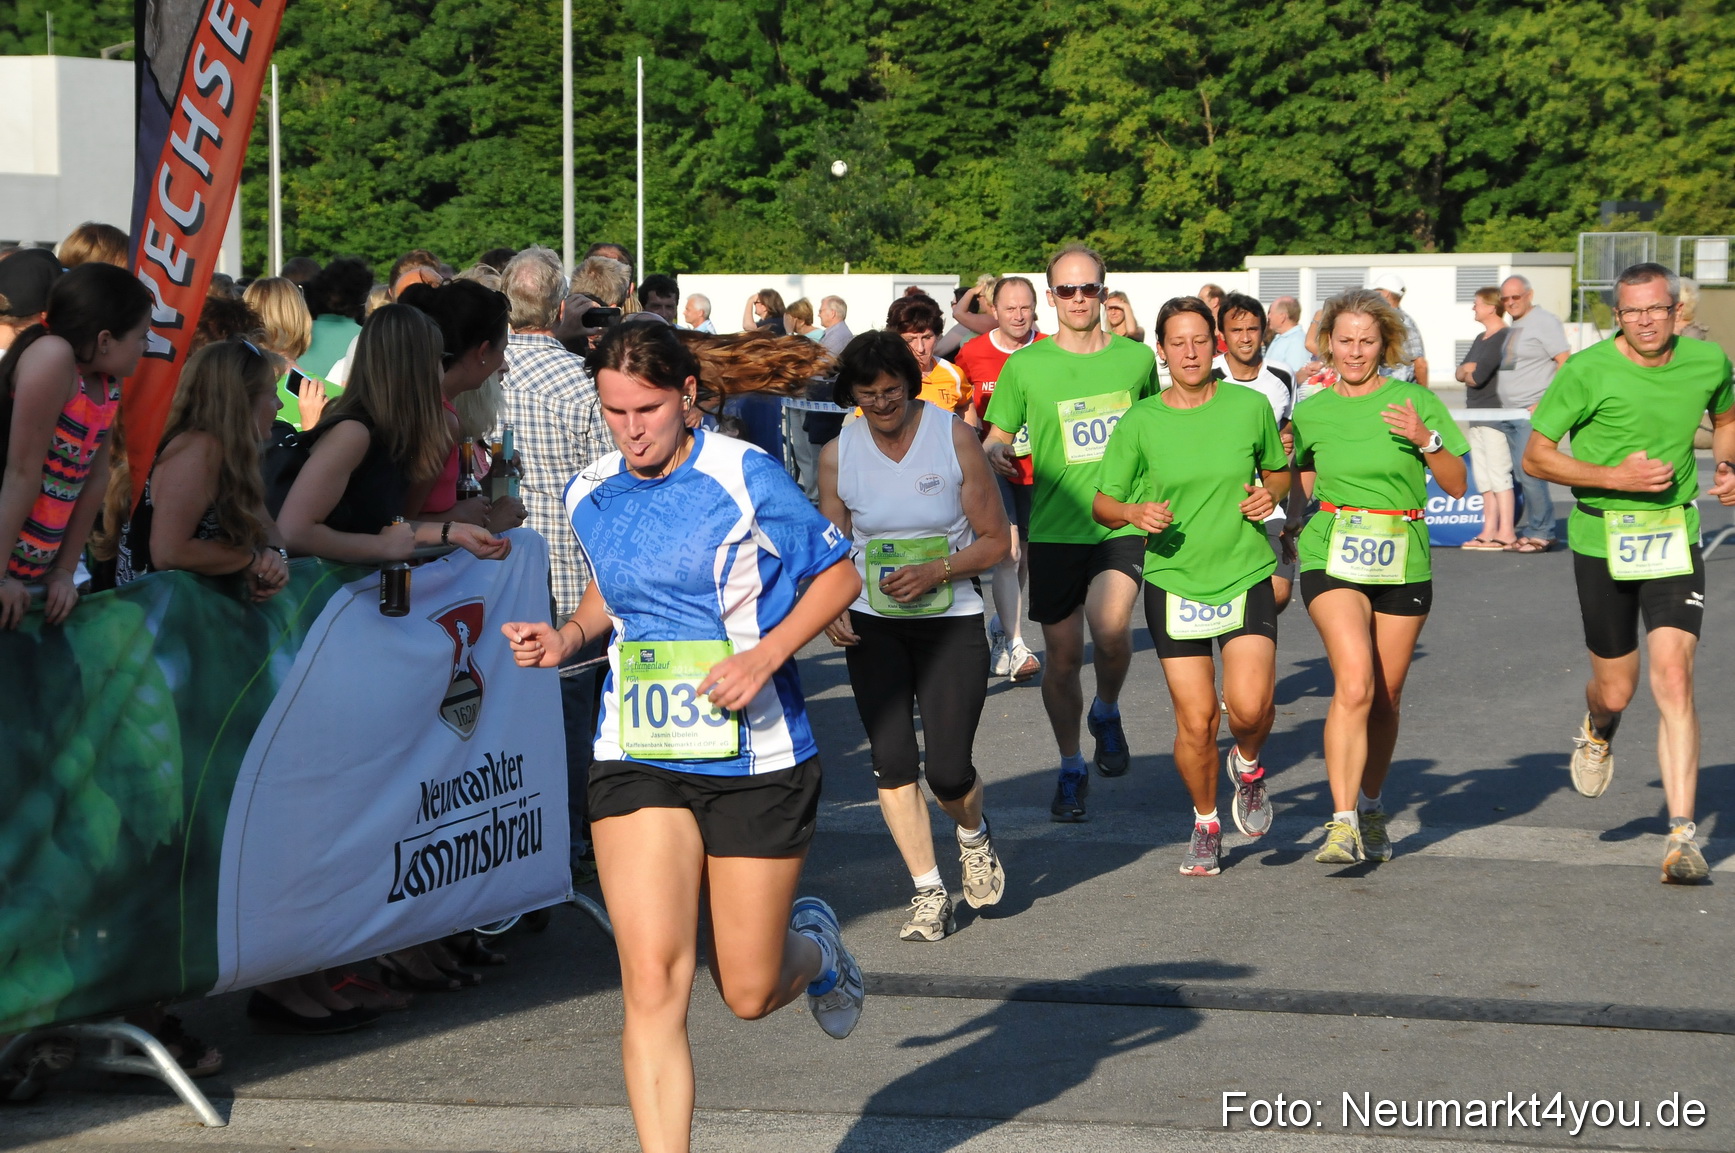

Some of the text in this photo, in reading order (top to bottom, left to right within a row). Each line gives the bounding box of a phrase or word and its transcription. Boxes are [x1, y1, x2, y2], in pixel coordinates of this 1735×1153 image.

[138, 0, 261, 362] WECHSE
[982, 381, 997, 391] NE
[1340, 536, 1396, 567] 580
[1619, 532, 1673, 563] 577
[387, 796, 543, 904] Lammsbräu
